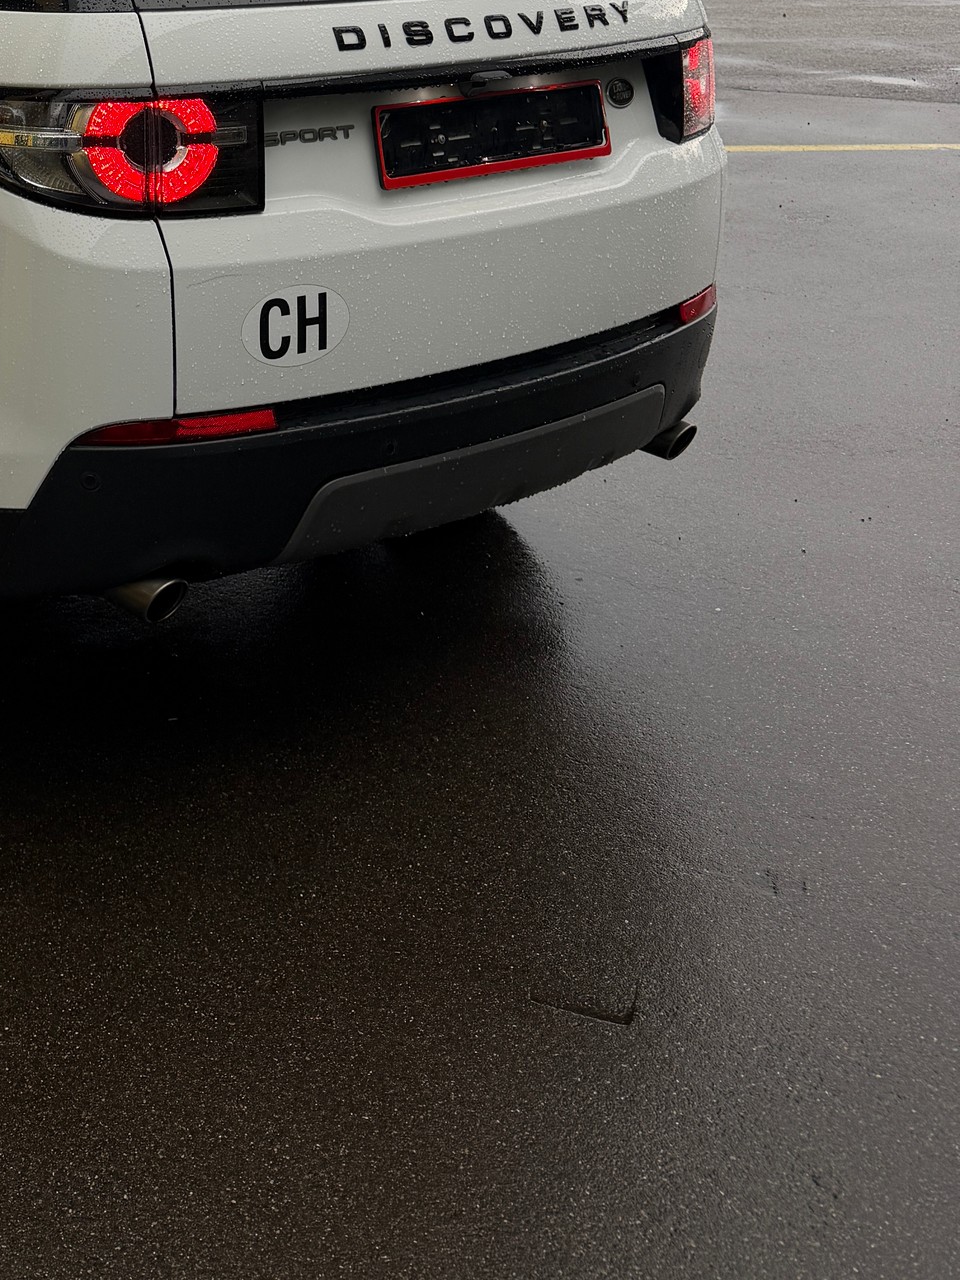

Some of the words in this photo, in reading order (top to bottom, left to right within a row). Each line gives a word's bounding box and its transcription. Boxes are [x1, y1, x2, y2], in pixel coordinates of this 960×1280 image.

[332, 1, 629, 51] DISCOVERY
[264, 124, 355, 147] SPORT
[260, 292, 327, 360] CH
